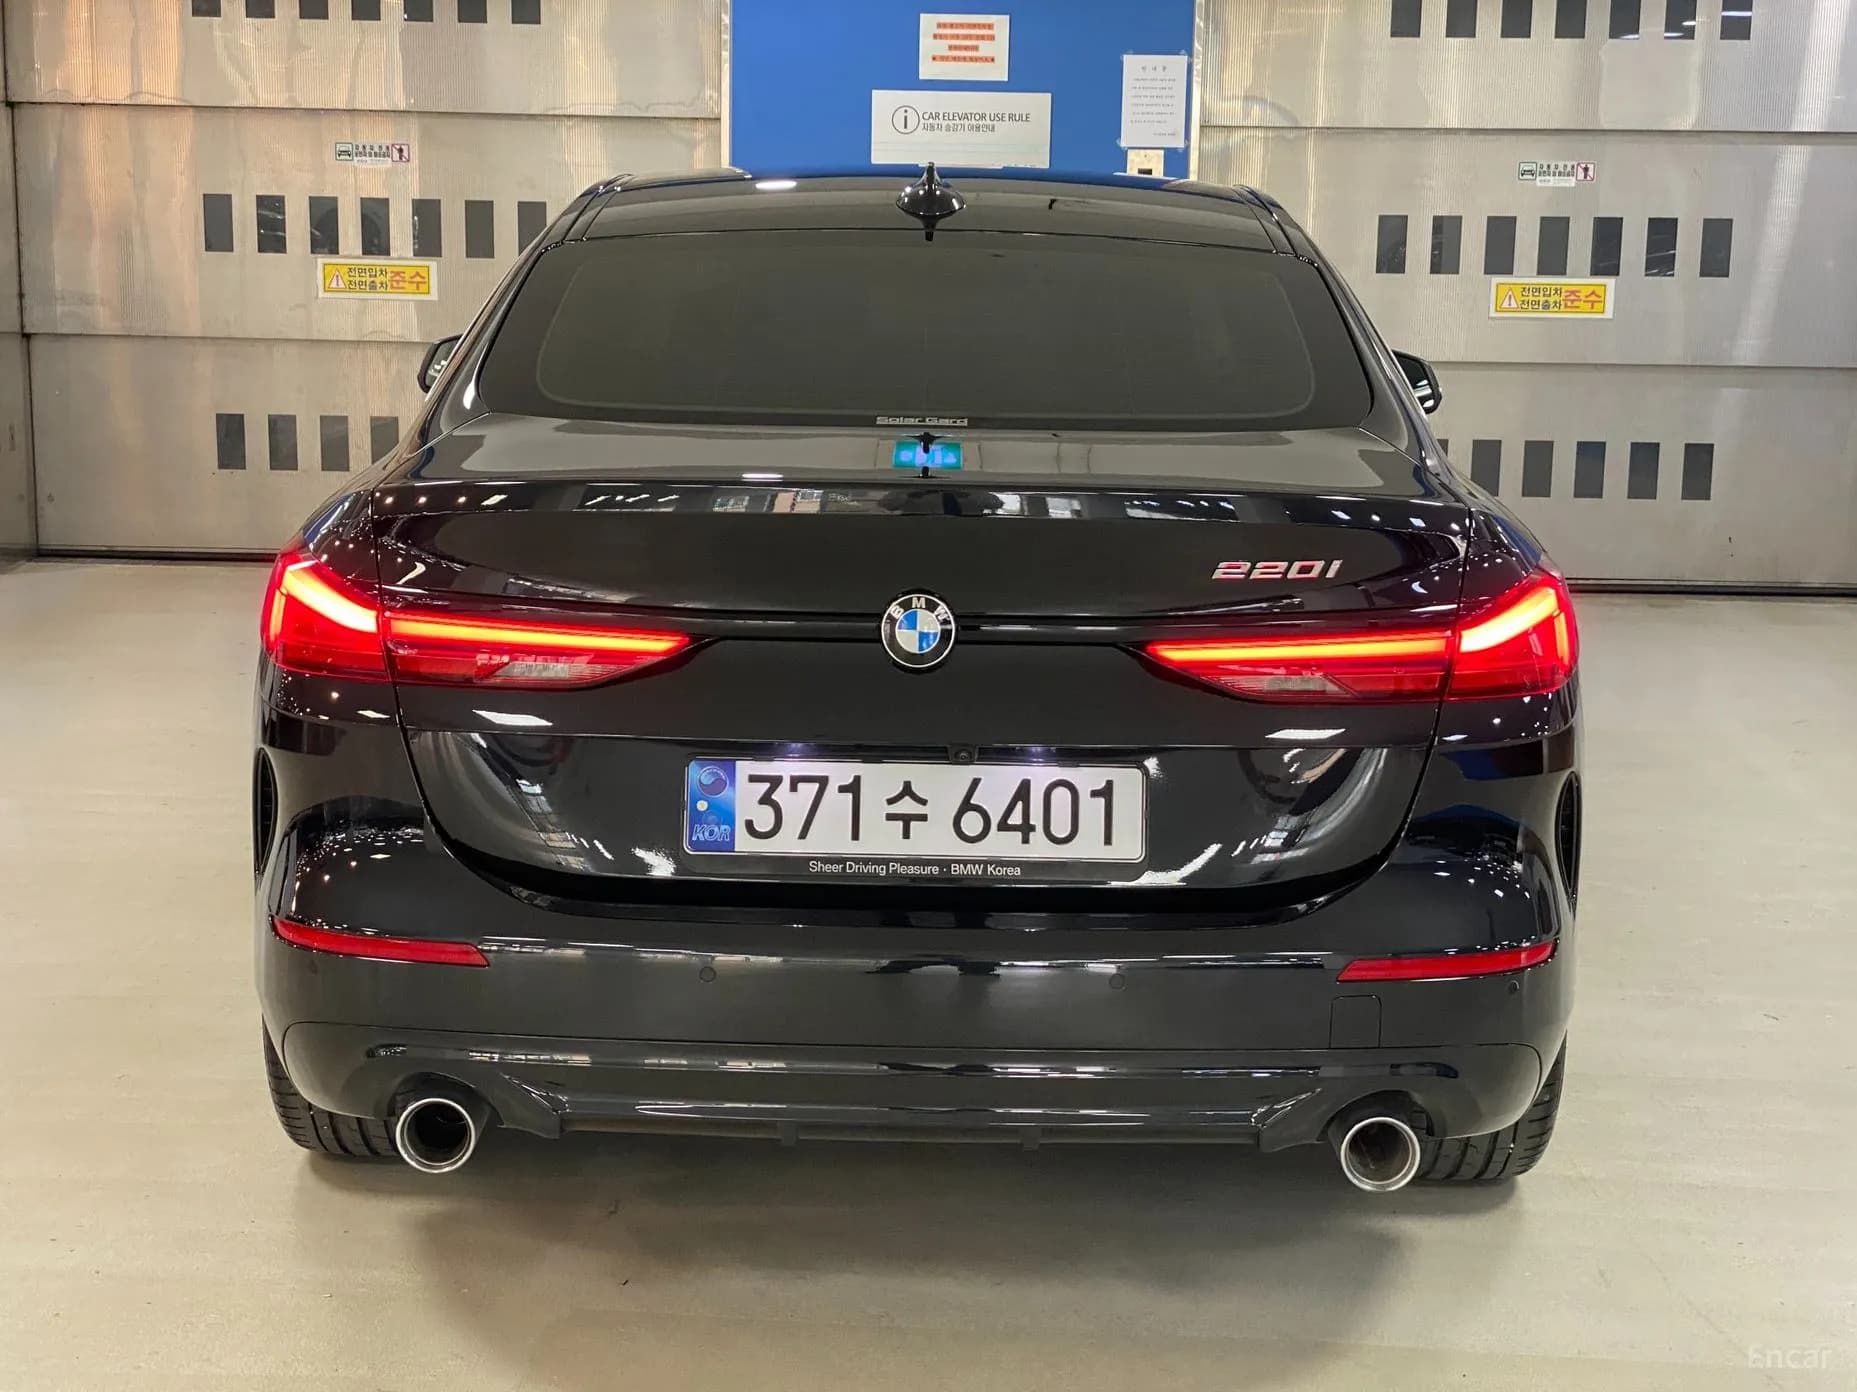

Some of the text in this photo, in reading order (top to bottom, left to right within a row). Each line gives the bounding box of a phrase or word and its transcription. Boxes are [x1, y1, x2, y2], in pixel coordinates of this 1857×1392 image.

[922, 112, 1031, 122] CAR ELEVATOR USE RULE
[922, 123, 943, 132] 자동차
[347, 267, 388, 278] 전면입차
[347, 280, 388, 290] 전면출차
[389, 270, 427, 291] 준수
[1521, 287, 1562, 298] 전면입차
[1520, 299, 1562, 310] 전면출차
[1562, 289, 1603, 310] 준수
[876, 416, 968, 426] Solar Gard
[890, 596, 951, 622] BMW
[952, 777, 1114, 845] 6401
[692, 823, 731, 841] KOR
[809, 861, 1022, 876] Sheer Driving Pleasure BMW Korea
